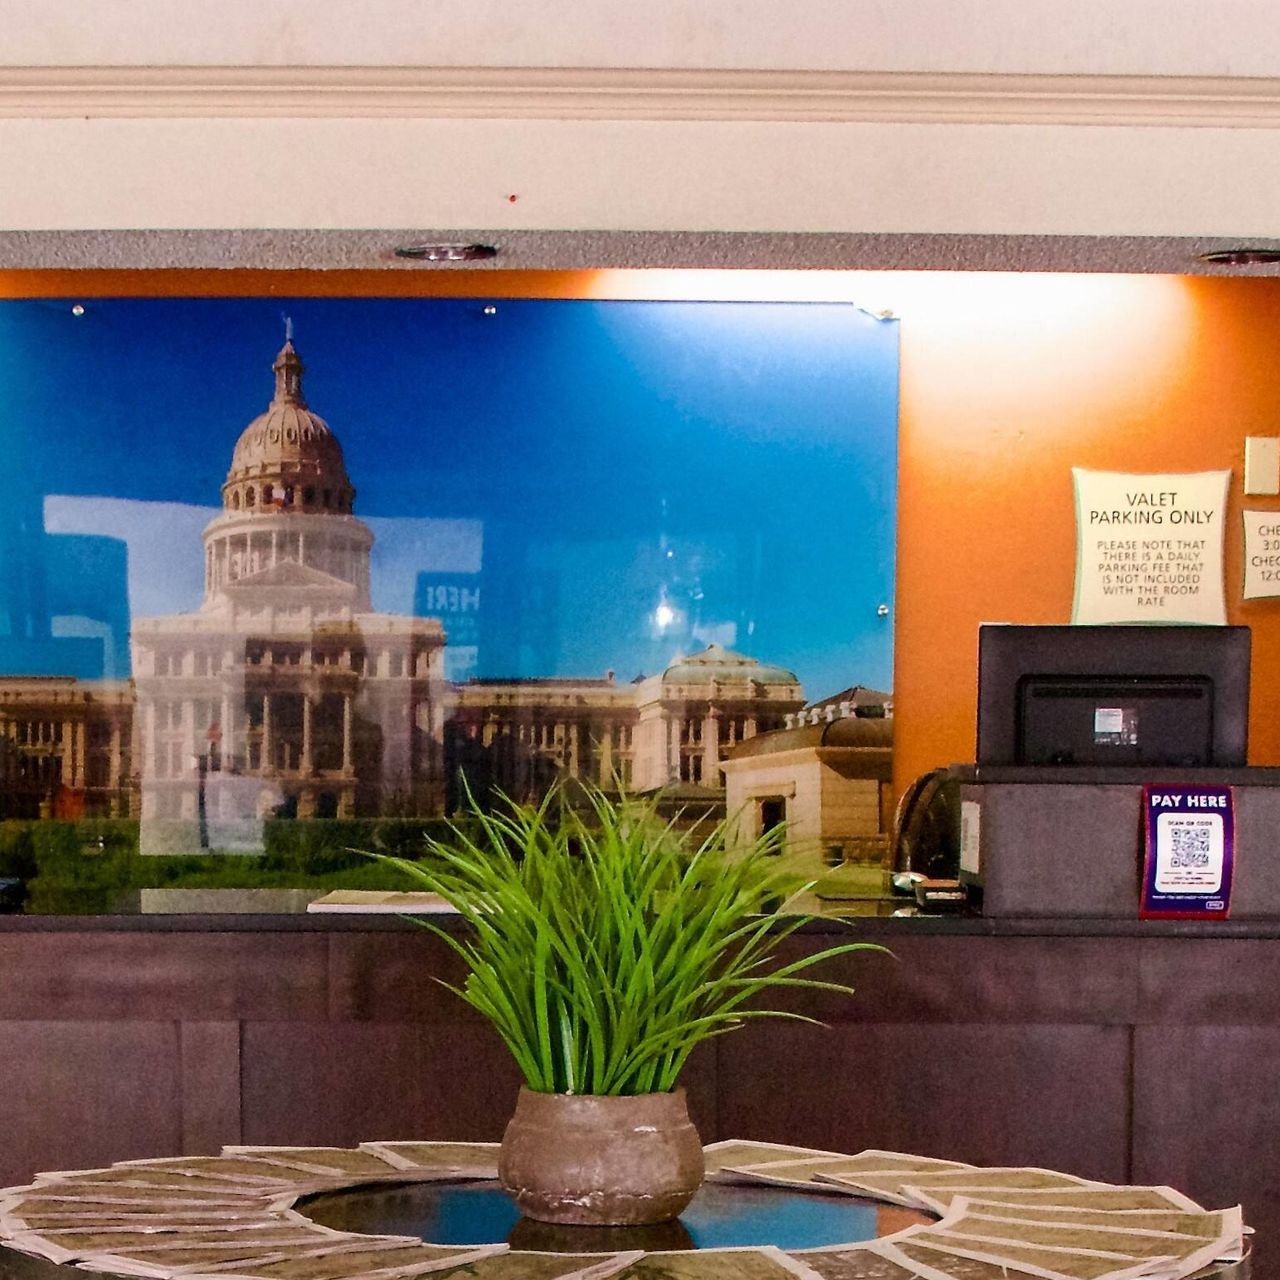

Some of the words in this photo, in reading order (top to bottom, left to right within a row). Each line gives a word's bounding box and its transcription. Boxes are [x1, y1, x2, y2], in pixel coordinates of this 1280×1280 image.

[1126, 492, 1177, 506] VALET
[1090, 510, 1163, 524] PARKING
[1170, 510, 1214, 524] ONLY
[1097, 541, 1137, 550] PLEASE
[1142, 540, 1172, 550] NOTE
[1177, 540, 1206, 550] THAT
[1103, 552, 1137, 561] THERE
[1142, 552, 1151, 561] IS
[1156, 552, 1164, 561] A
[1168, 552, 1200, 561] DAILY
[1098, 563, 1148, 572] PARKING
[1153, 563, 1171, 572] FEE
[1176, 563, 1204, 572] THAT
[1102, 575, 1111, 584] IS
[1116, 575, 1139, 584] NOT
[1144, 574, 1200, 584] INCLUDED
[1103, 586, 1133, 595] WITH
[1138, 586, 1158, 595] THE
[1164, 586, 1200, 595] ROOM
[1137, 597, 1165, 606] RATE
[1151, 795, 1182, 807] PAY
[1187, 795, 1227, 808] HERE
